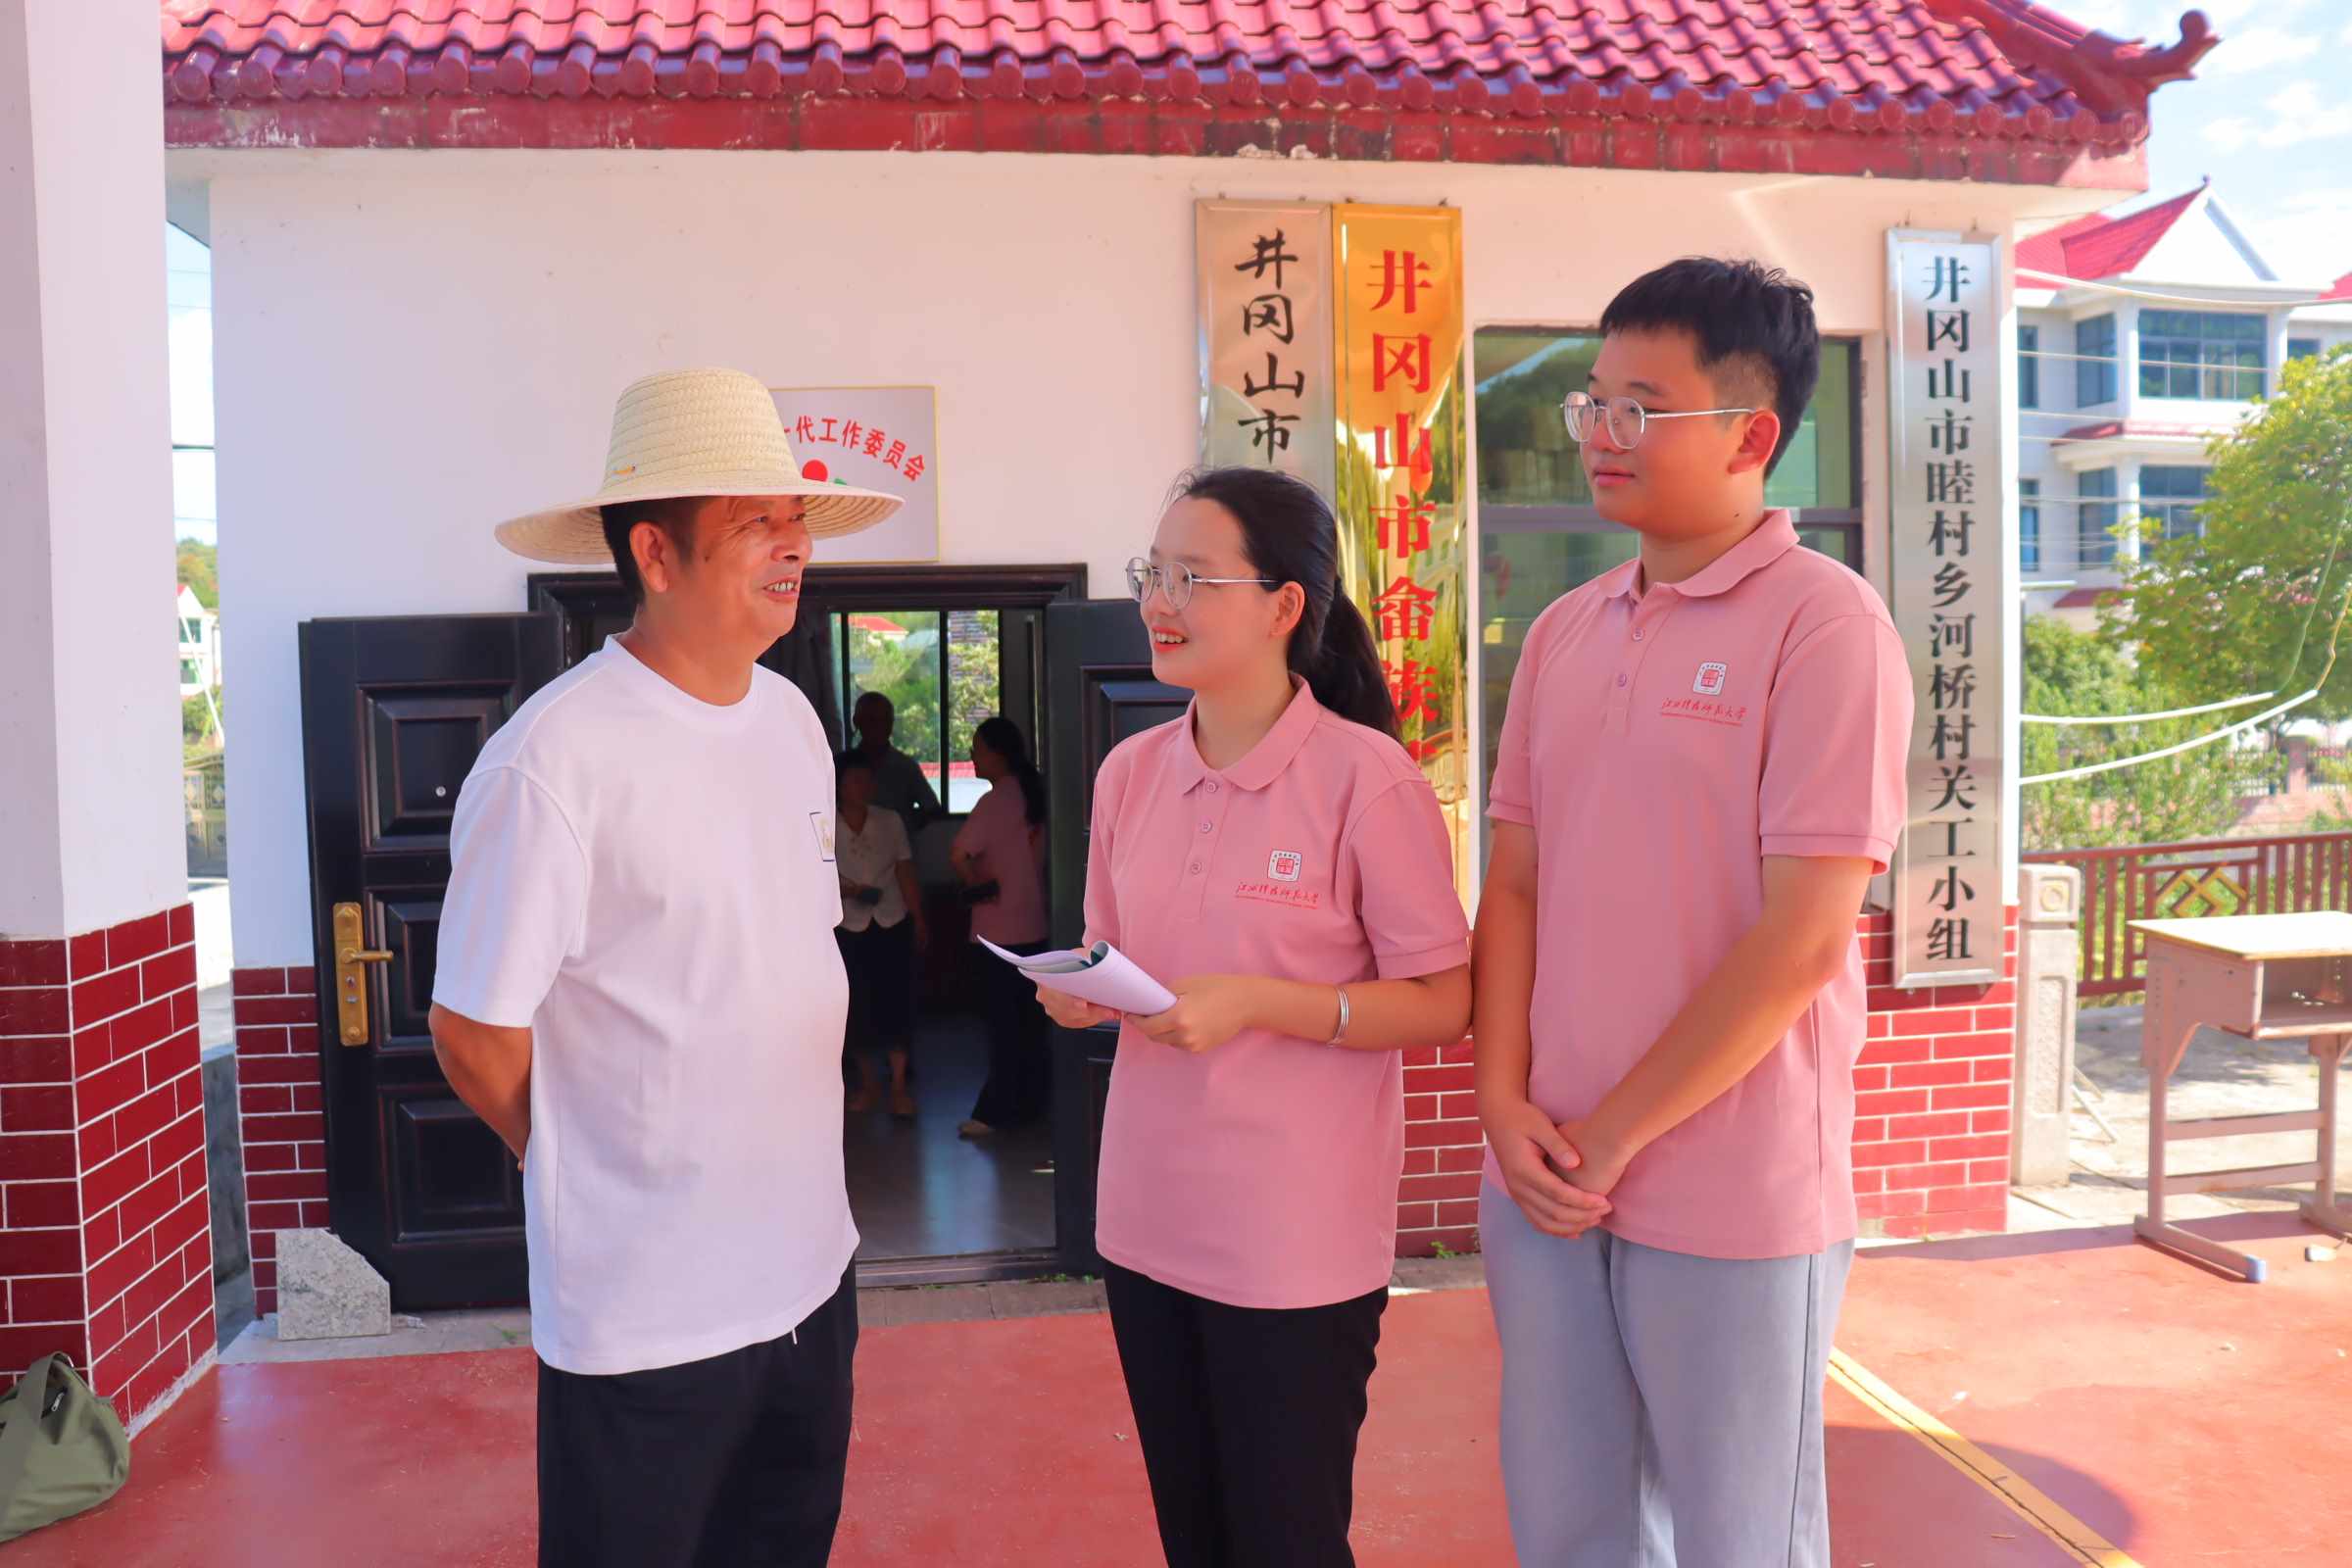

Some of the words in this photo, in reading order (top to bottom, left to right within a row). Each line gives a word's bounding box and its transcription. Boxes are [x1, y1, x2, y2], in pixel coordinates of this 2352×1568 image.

[1234, 228, 1304, 464] 井冈山市
[1366, 249, 1438, 762] 井冈山市畲族
[1922, 255, 1976, 961] 井冈山市睦村乡河桥村关工小组
